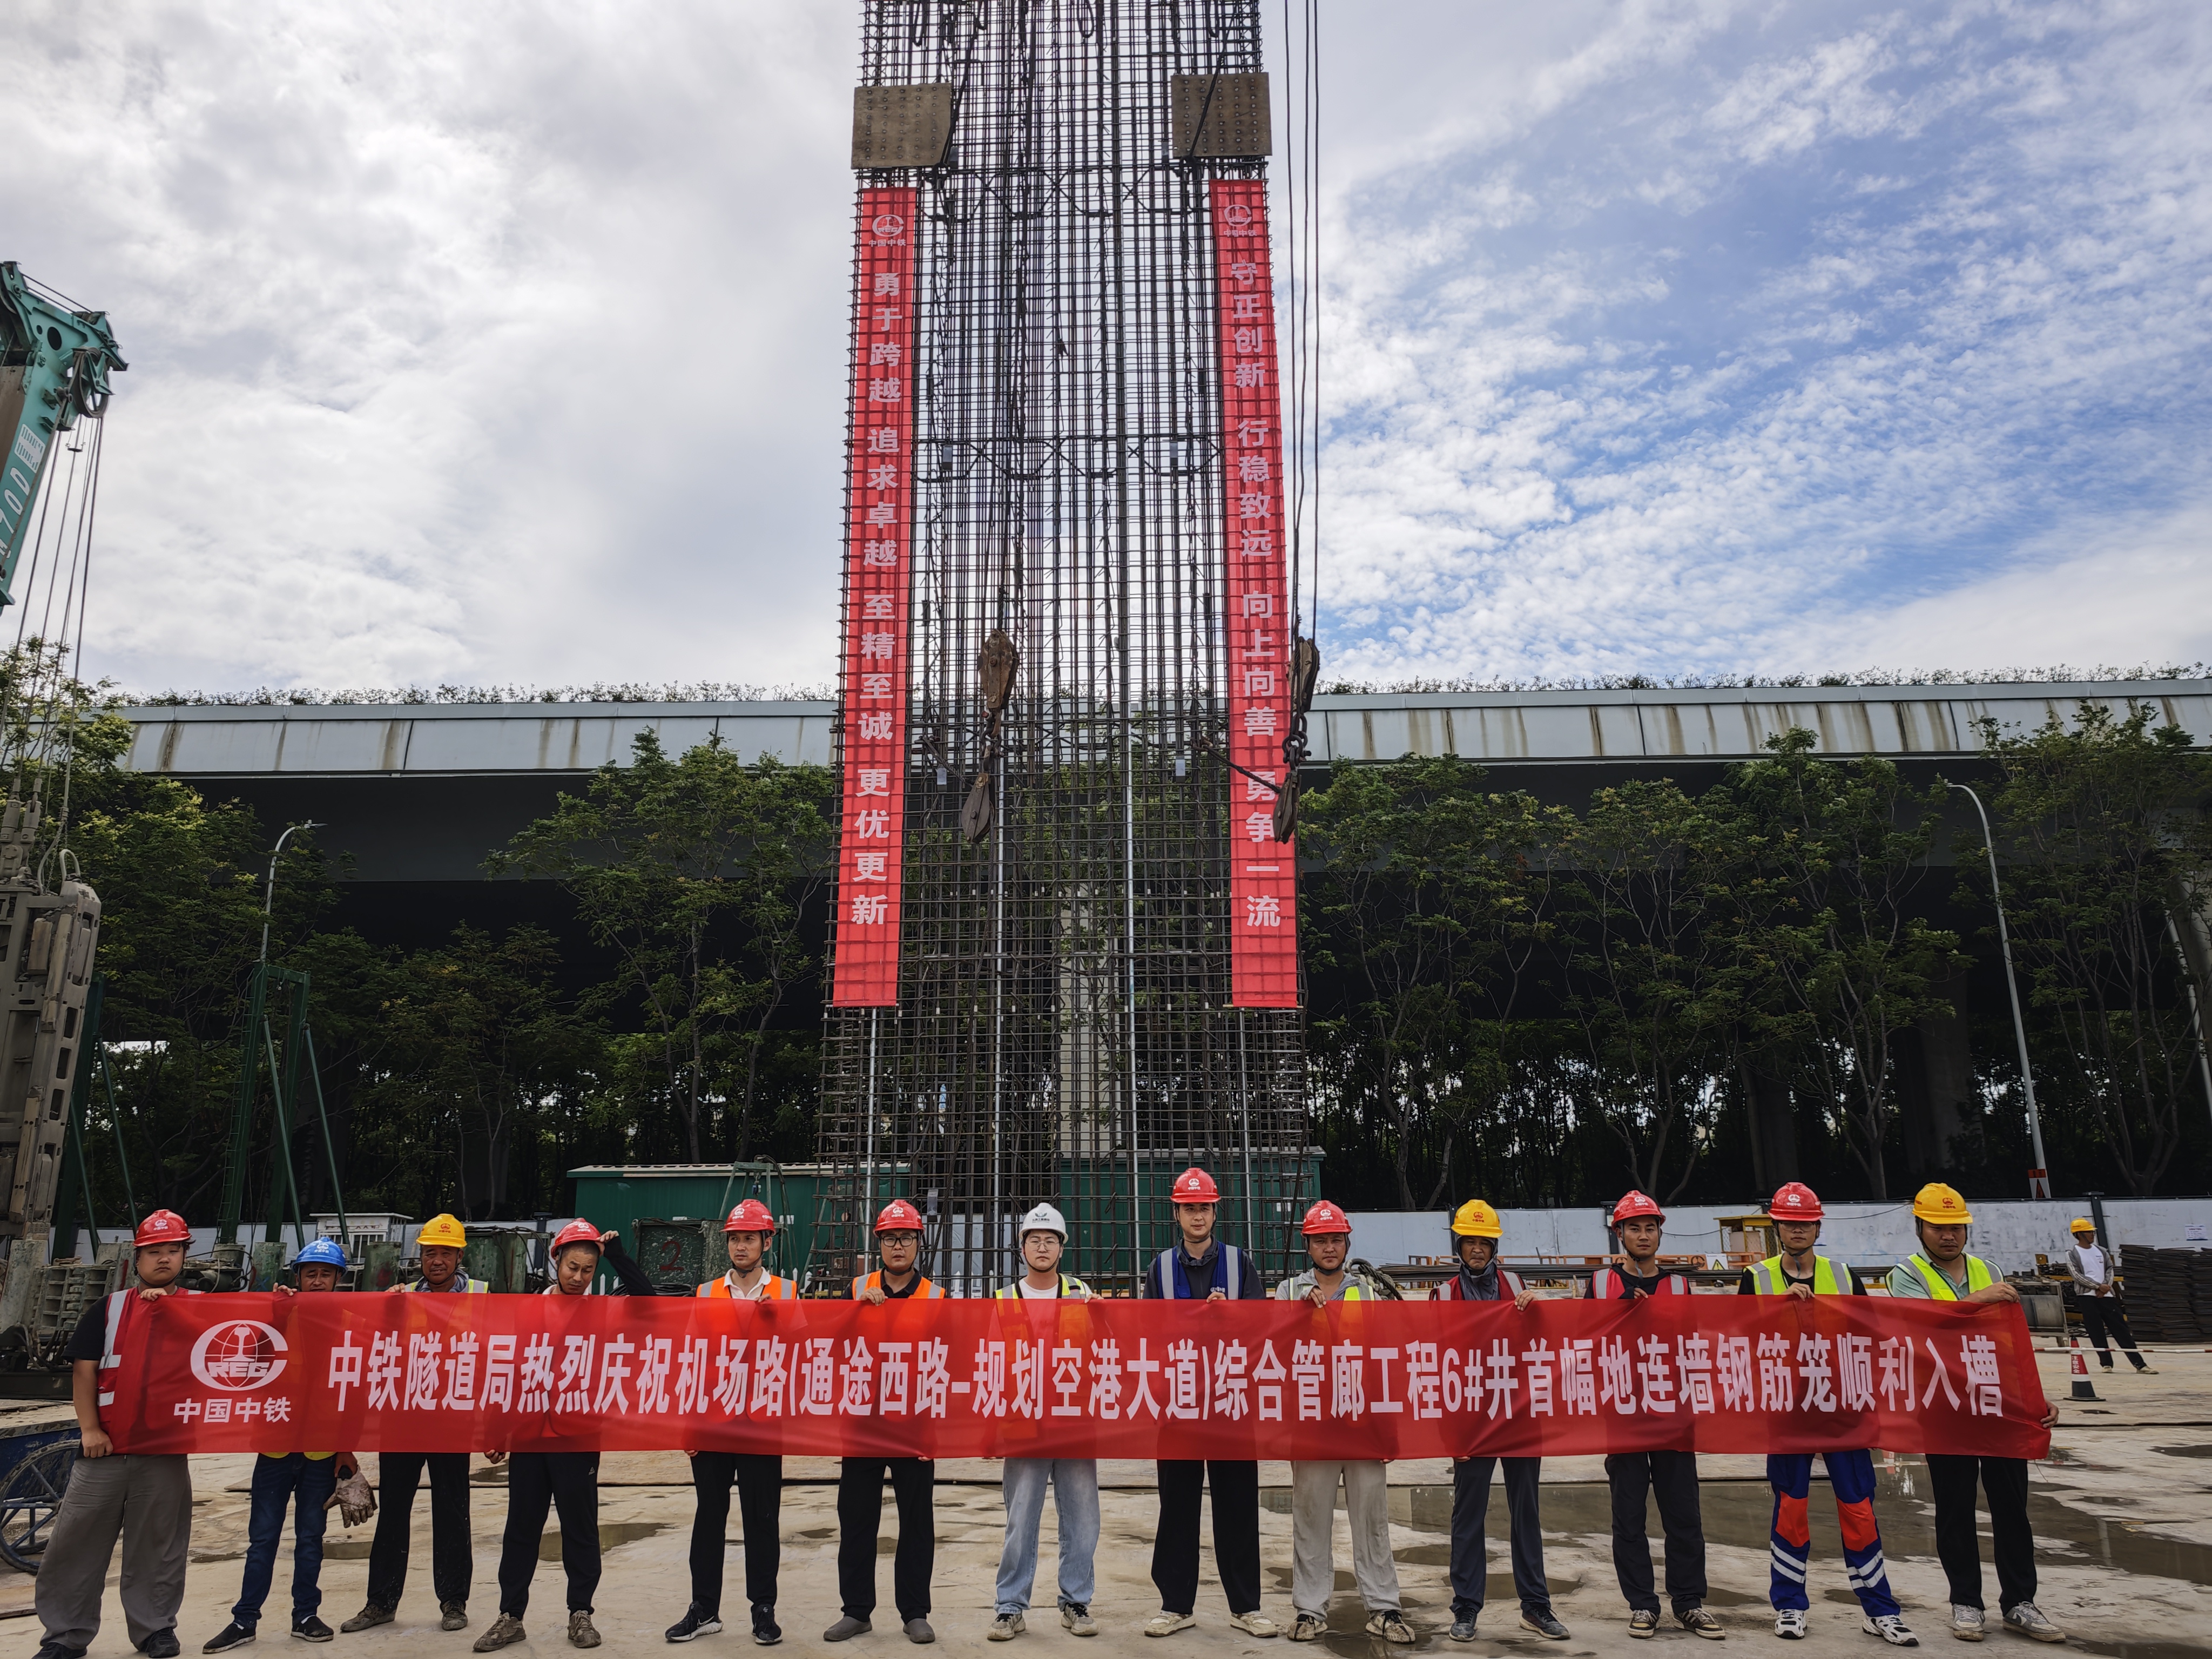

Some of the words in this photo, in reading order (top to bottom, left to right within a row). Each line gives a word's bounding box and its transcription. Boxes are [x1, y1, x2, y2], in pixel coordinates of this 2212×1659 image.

[868, 239, 906, 247] 中国中铁
[868, 273, 902, 403] 勇于跨越
[1231, 259, 1265, 388] 守正创新
[864, 427, 899, 567] 追求卓越
[1238, 419, 1272, 557] 行稳致远
[858, 594, 895, 740] 至精至诚
[1243, 590, 1277, 737] 向上向善
[851, 768, 891, 925] 更优更新
[1245, 771, 1280, 927] 勇争一流
[659, 1240, 684, 1271] 2
[173, 1397, 291, 1424] 中国中铁
